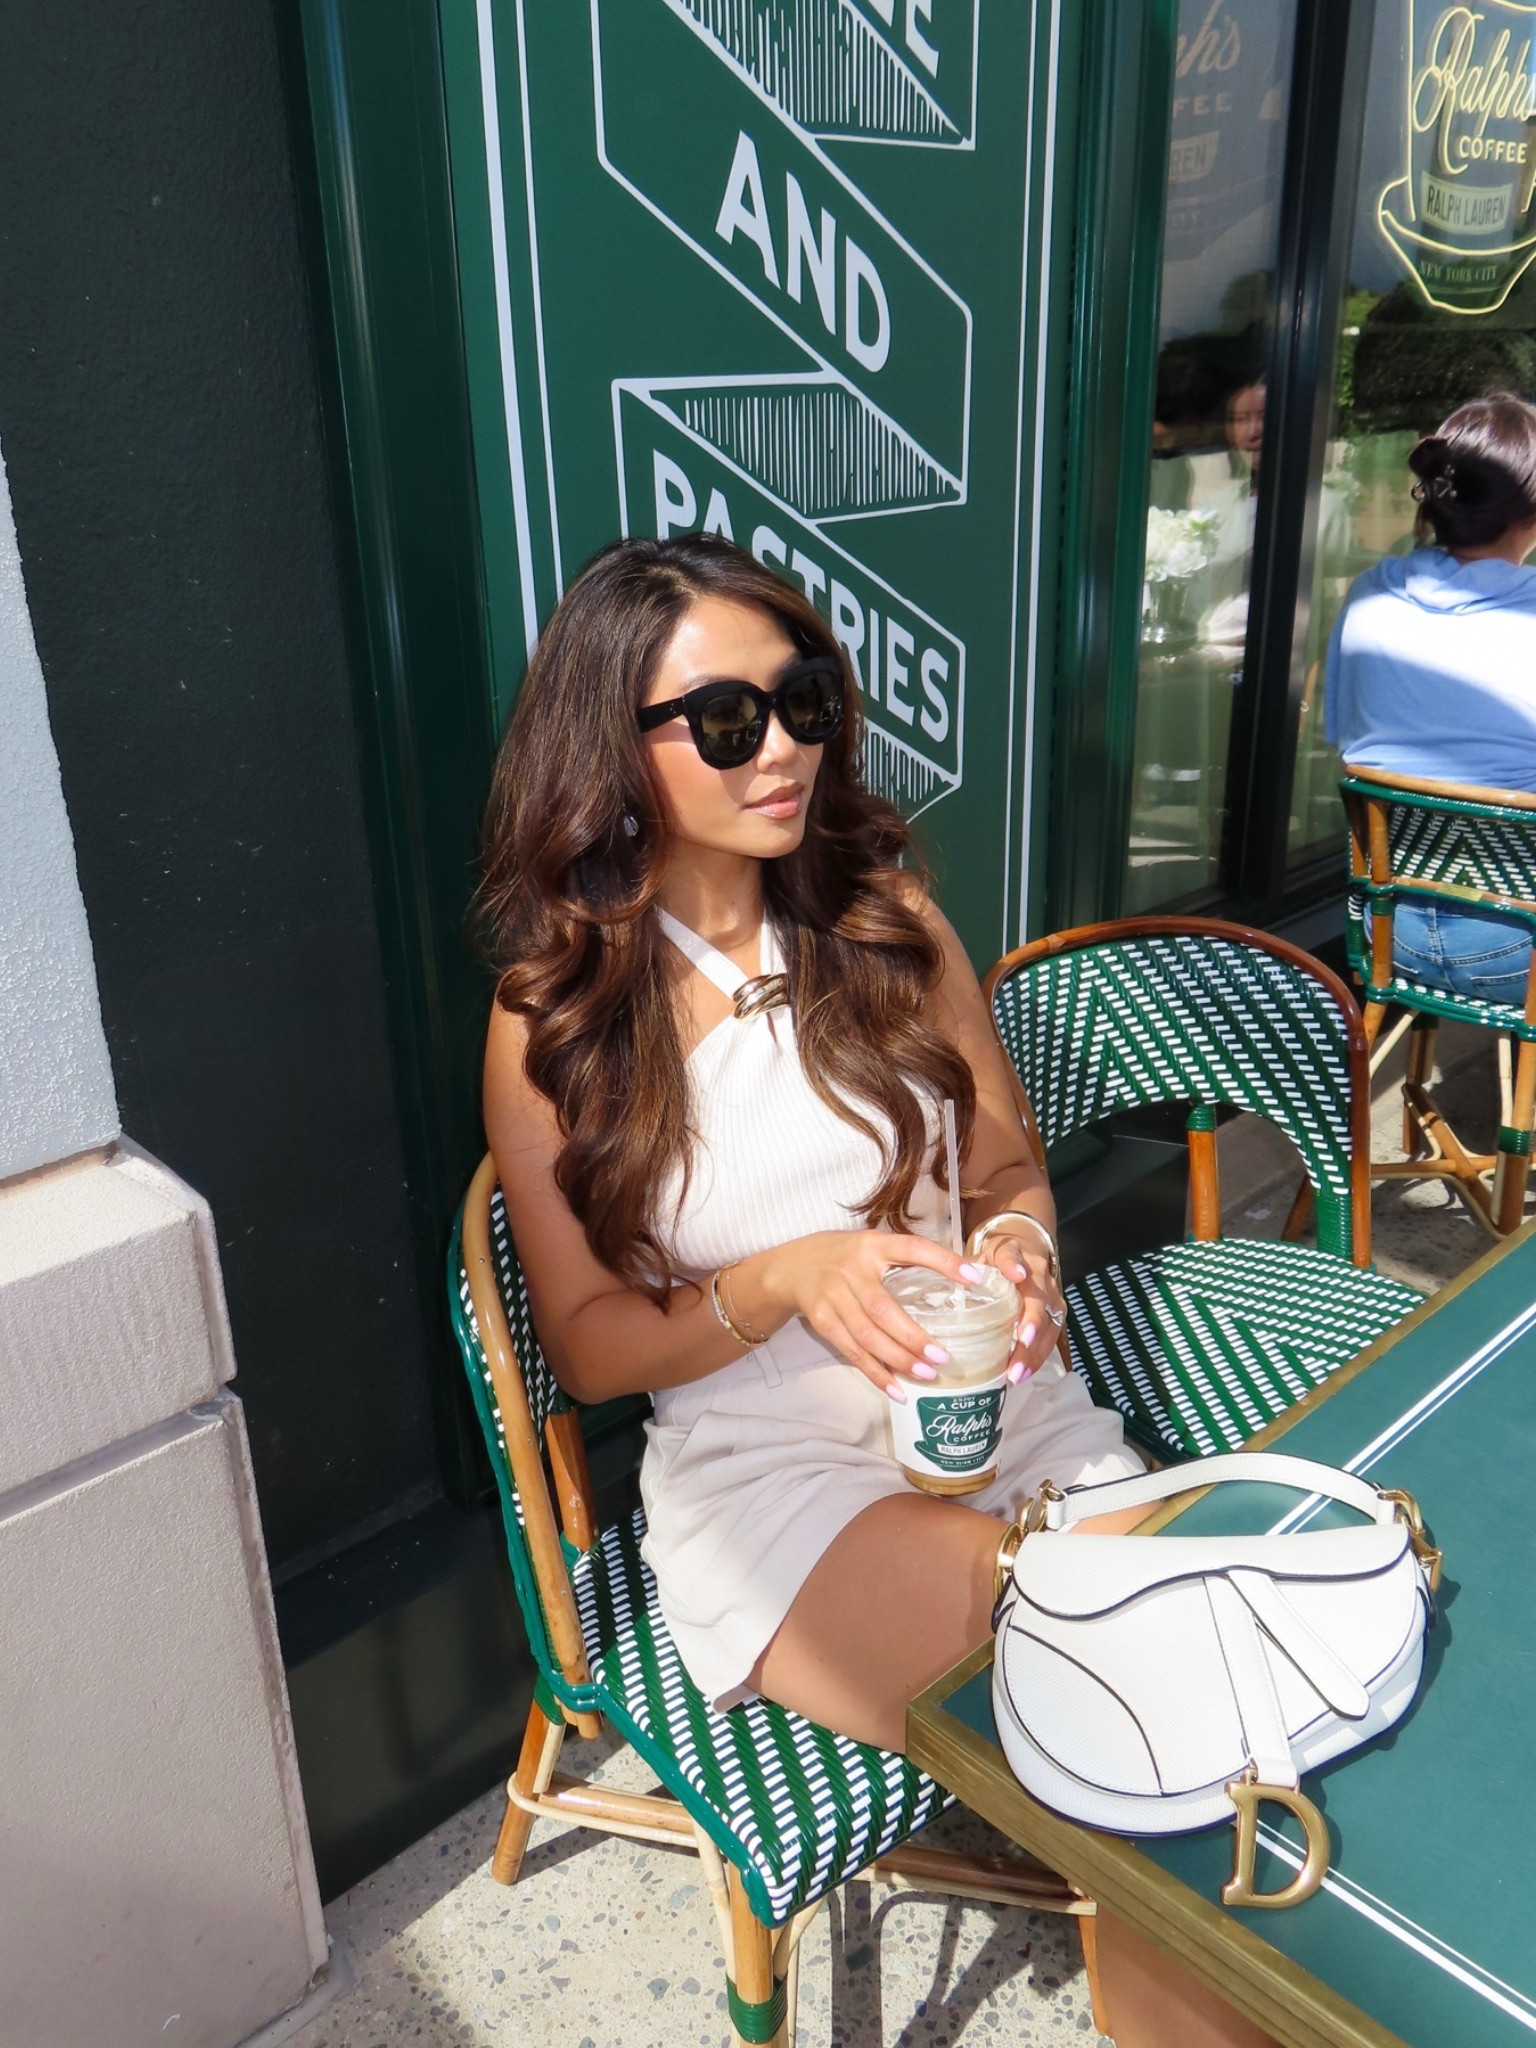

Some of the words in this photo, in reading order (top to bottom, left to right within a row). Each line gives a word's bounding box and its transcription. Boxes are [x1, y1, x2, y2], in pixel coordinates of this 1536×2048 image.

[1173, 93, 1232, 119] FEE
[1459, 135, 1528, 164] COFFEE
[1426, 184, 1462, 225] RALPH
[1463, 193, 1507, 226] LAUREN
[715, 129, 891, 373] AND
[1420, 260, 1442, 279] NEW
[1445, 266, 1473, 283] YORK
[1475, 264, 1498, 282] CITY
[951, 1401, 976, 1410] CUP
[978, 1397, 992, 1406] OF
[926, 1411, 993, 1446] Ralph's
[953, 1429, 991, 1443] COFFEE
[940, 1444, 962, 1455] RALPH
[962, 1442, 986, 1455] LAUREN
